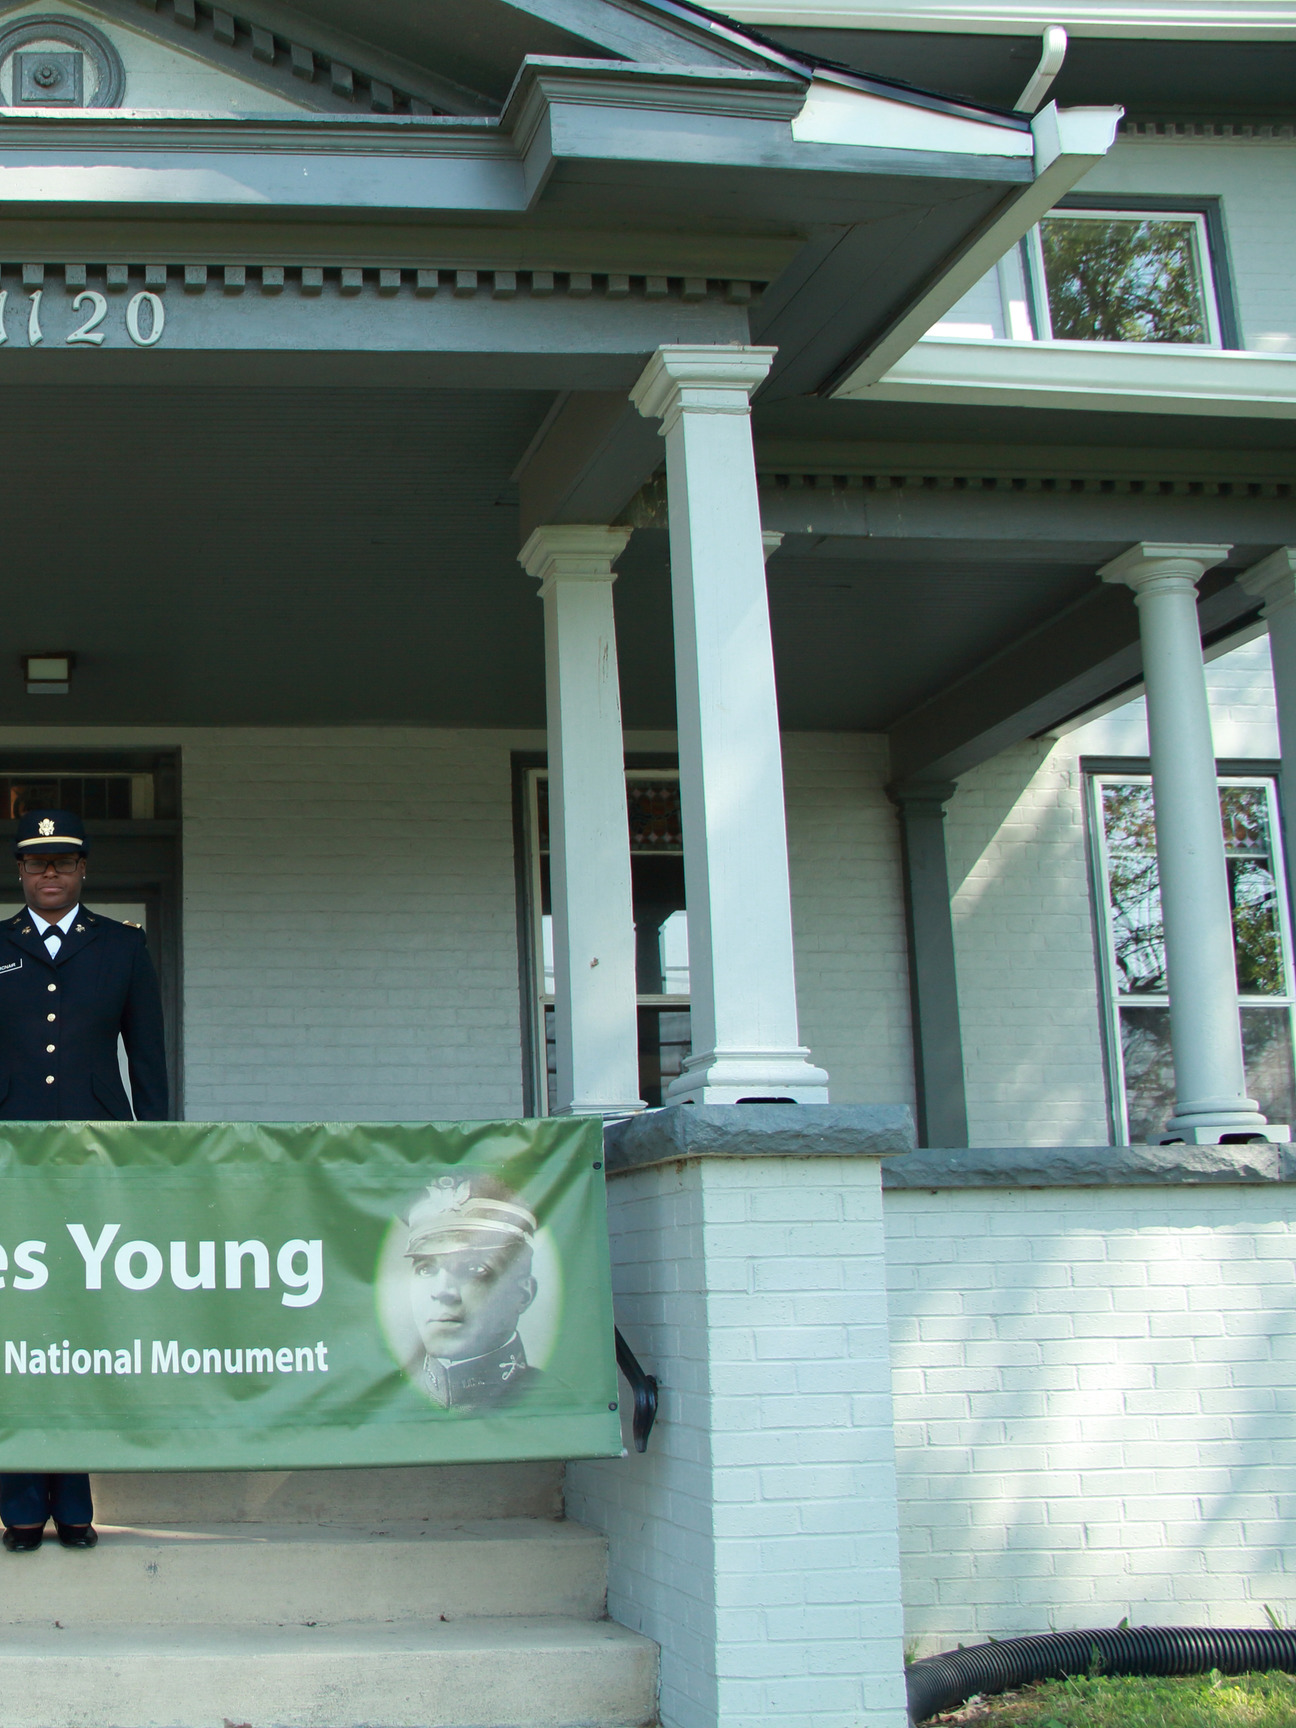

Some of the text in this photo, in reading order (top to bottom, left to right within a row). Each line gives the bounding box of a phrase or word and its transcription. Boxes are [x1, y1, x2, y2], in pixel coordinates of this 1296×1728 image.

[65, 1223, 324, 1308] Young
[4, 1338, 142, 1374] National
[151, 1340, 329, 1374] Monument
